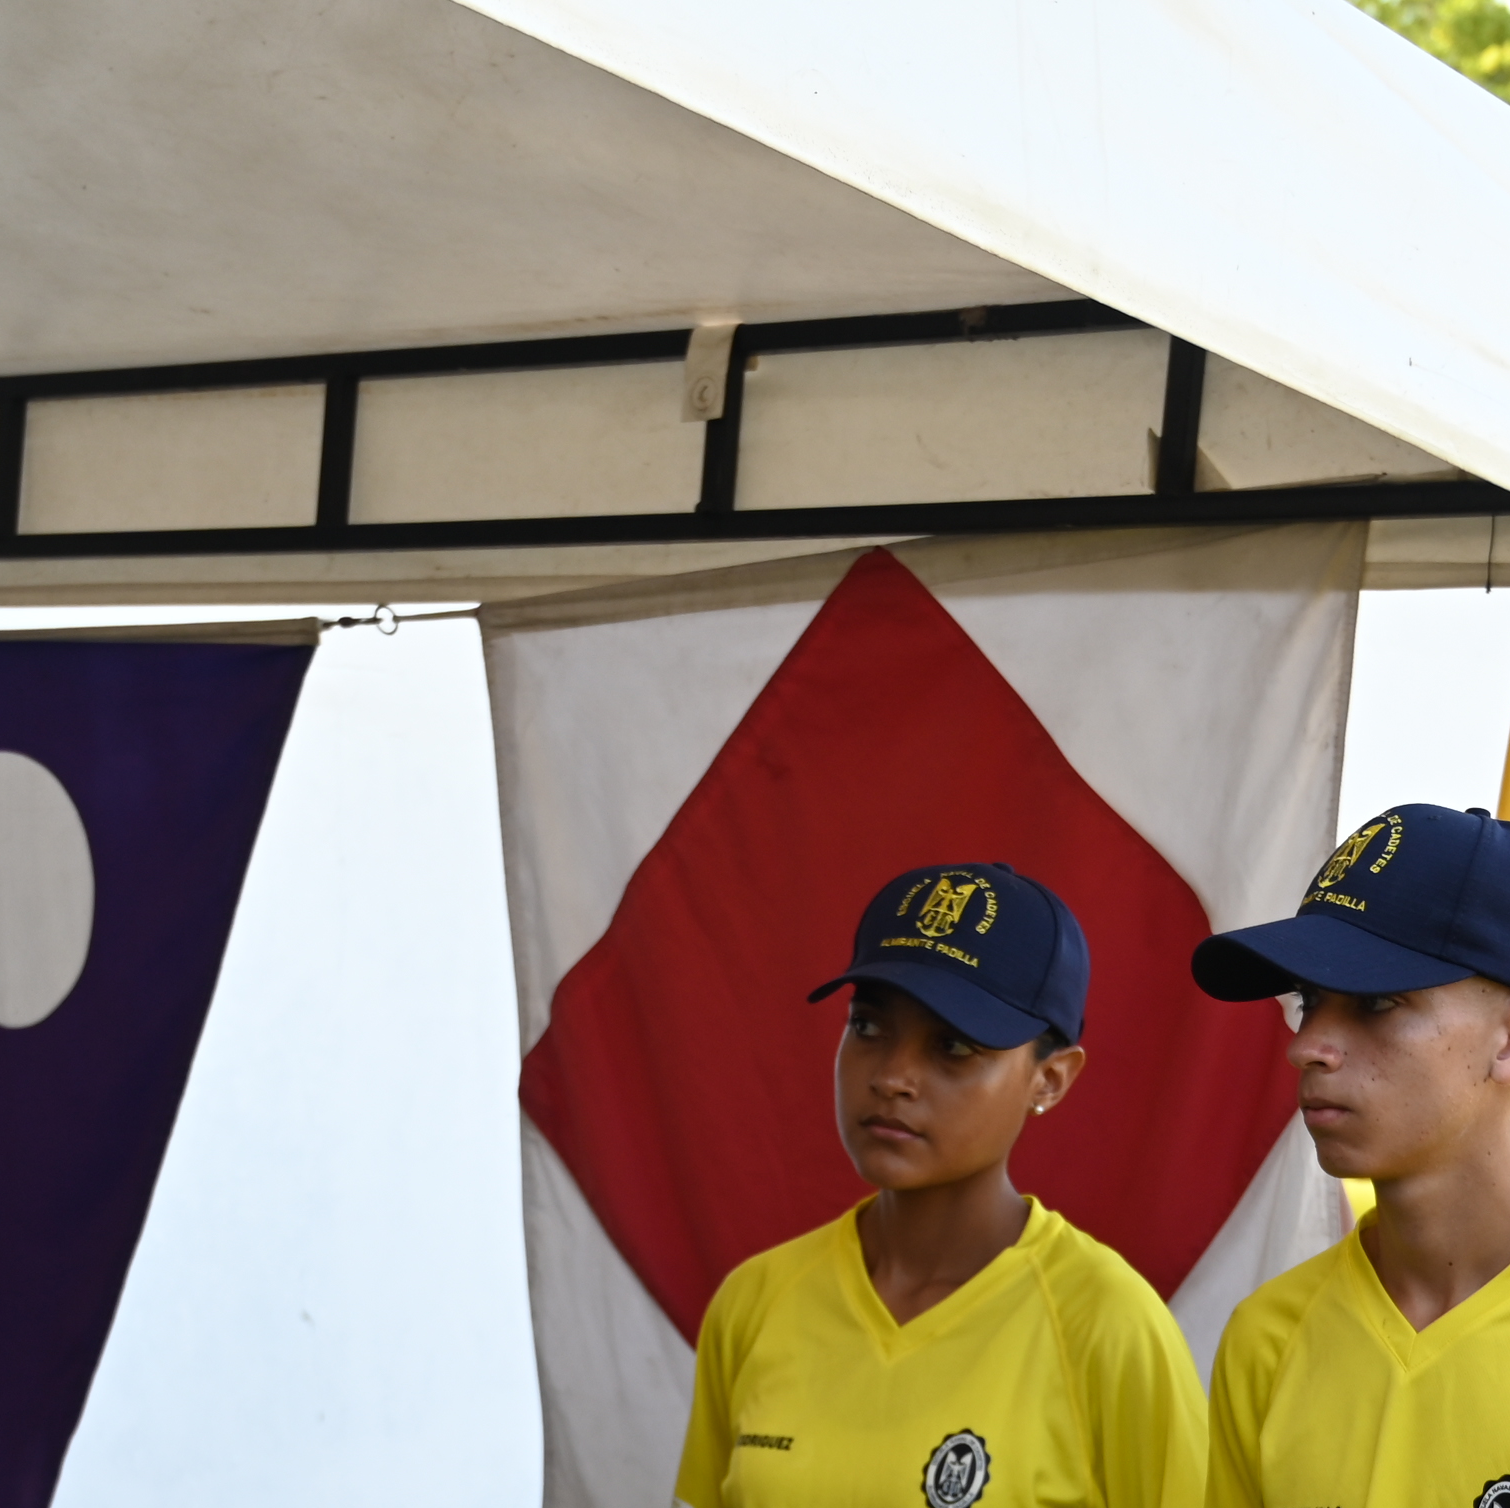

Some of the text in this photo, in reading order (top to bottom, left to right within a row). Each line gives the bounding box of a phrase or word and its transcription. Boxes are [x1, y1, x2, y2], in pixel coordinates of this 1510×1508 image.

[1370, 826, 1403, 873] CADETES
[975, 891, 999, 934] CADETES
[1324, 893, 1366, 911] PADILLA
[936, 943, 979, 968] PADILLA
